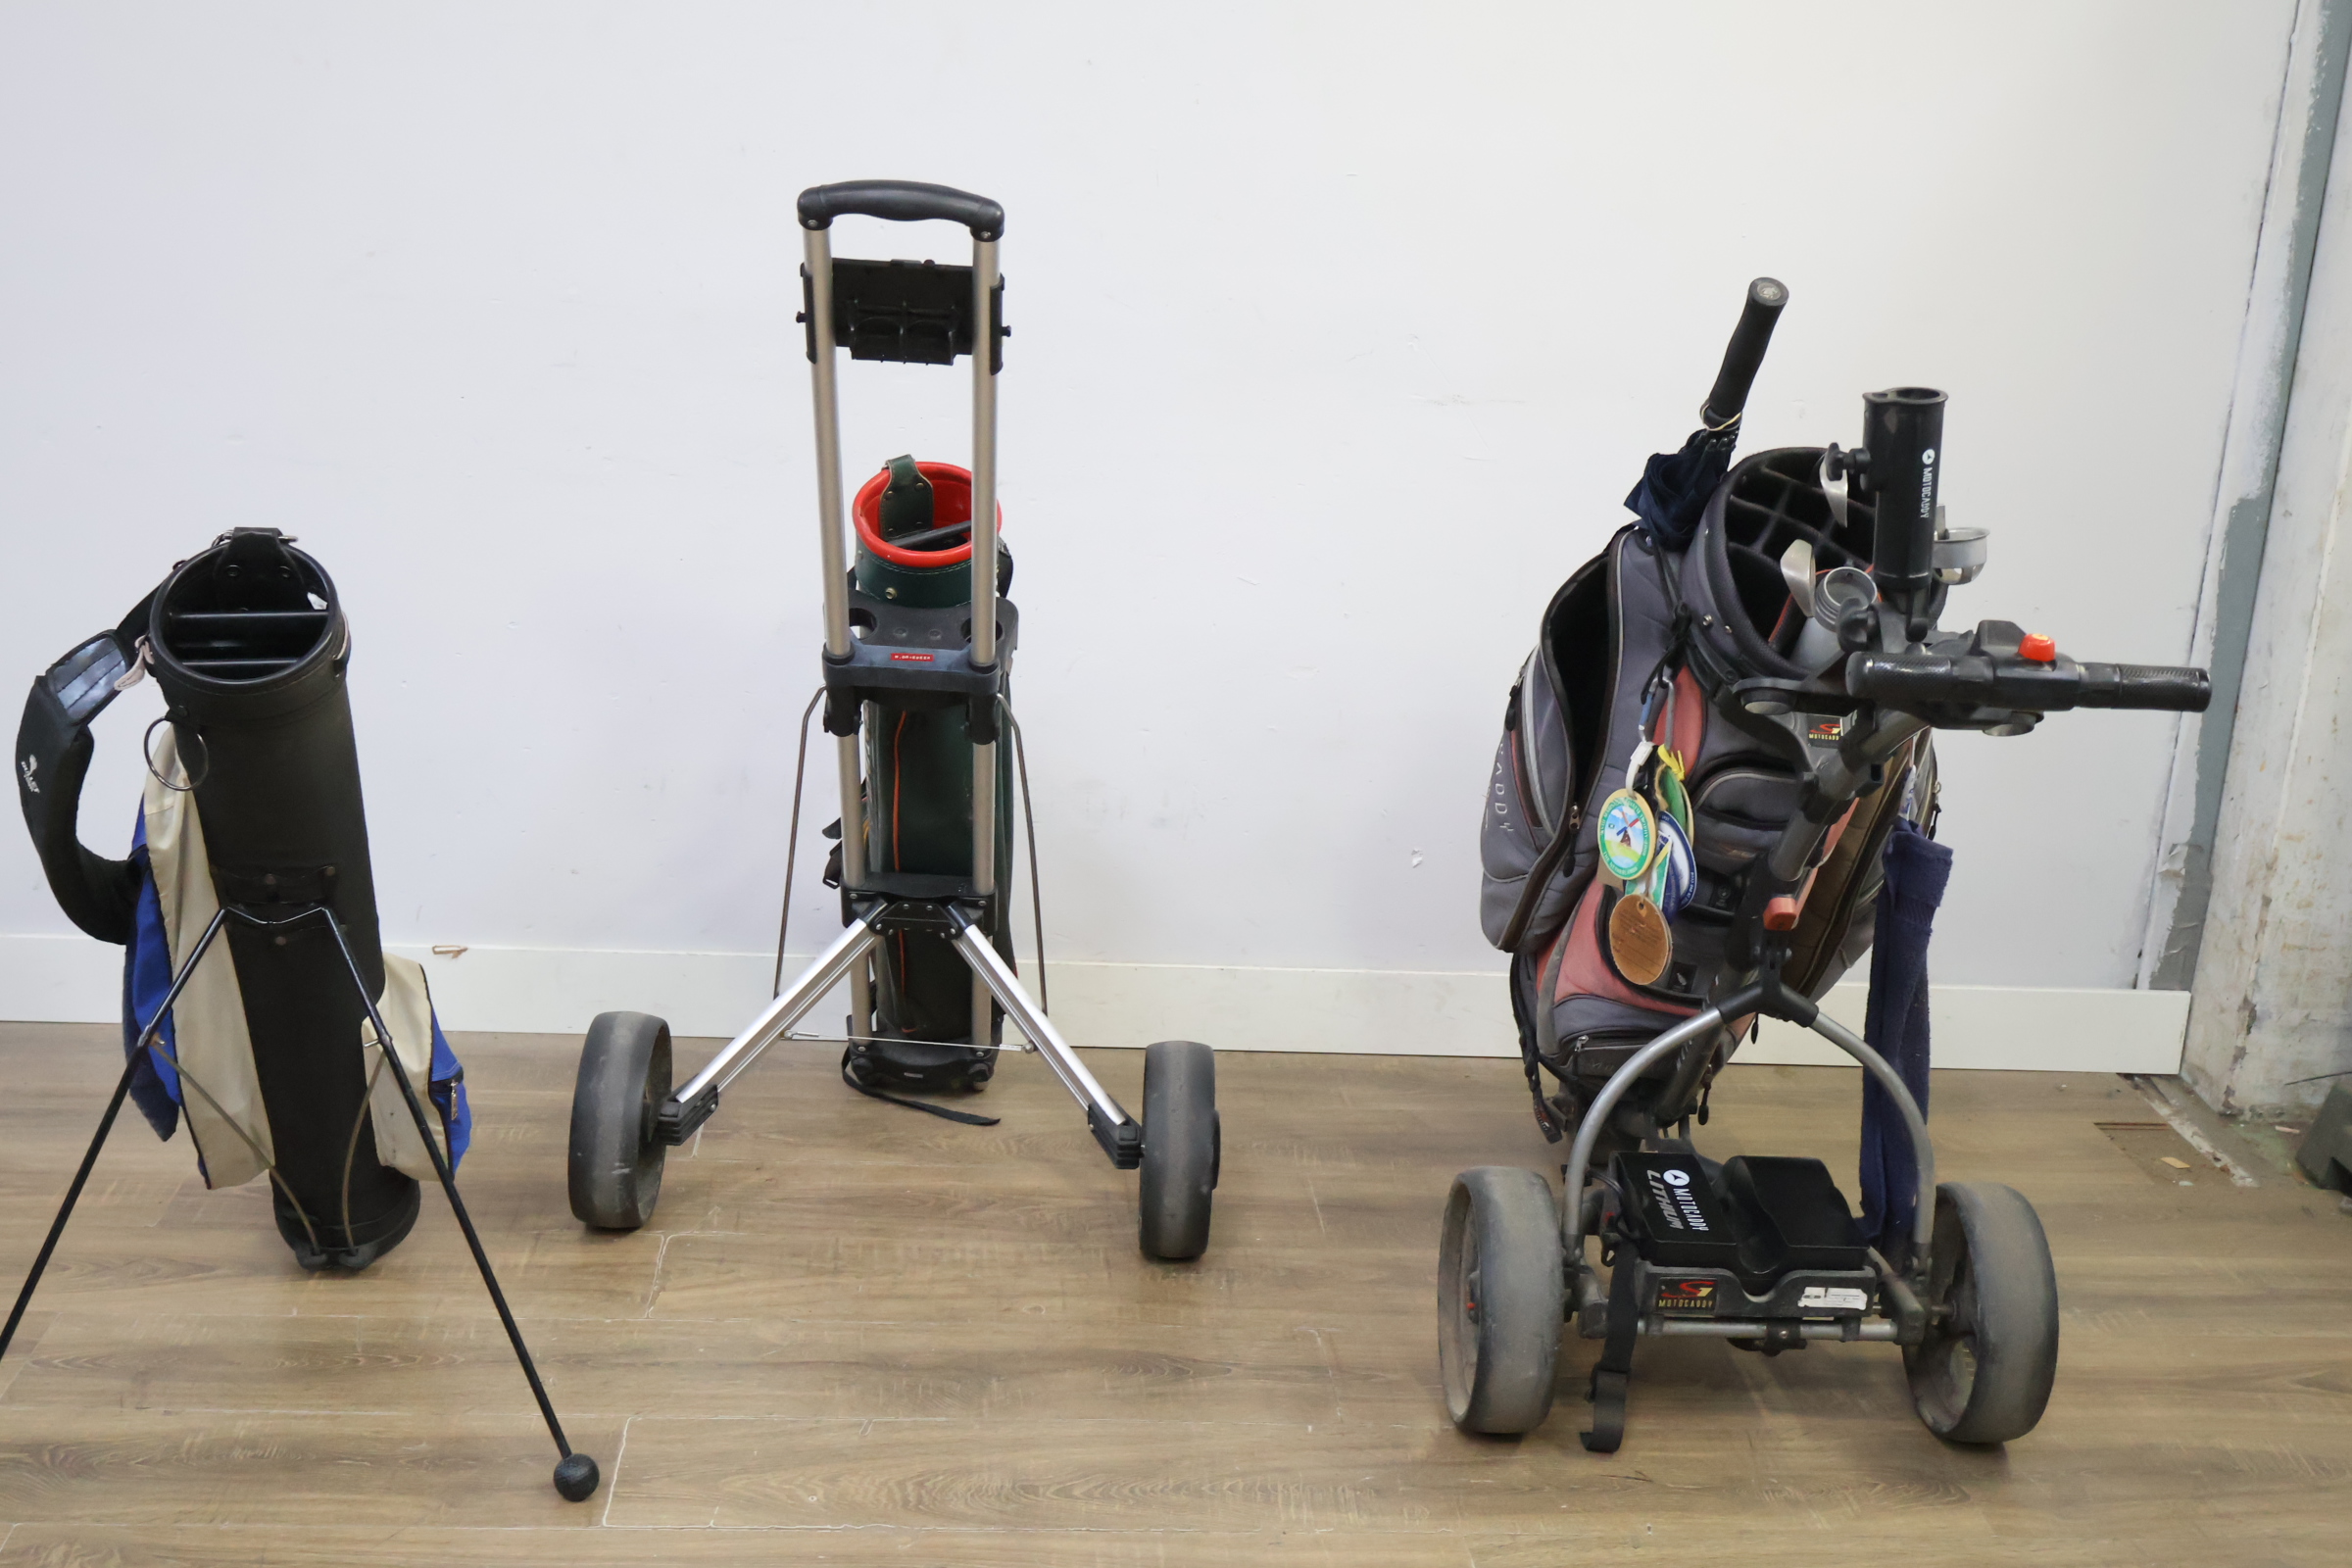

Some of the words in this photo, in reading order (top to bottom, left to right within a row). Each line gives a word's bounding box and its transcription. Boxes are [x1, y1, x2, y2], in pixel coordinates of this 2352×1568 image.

[1920, 466, 1934, 518] MOTOCADDY
[1646, 1169, 1685, 1230] LITHIUM
[1673, 1188, 1709, 1231] MOTOCADDY
[1658, 1298, 1714, 1308] MOTOCADDY
